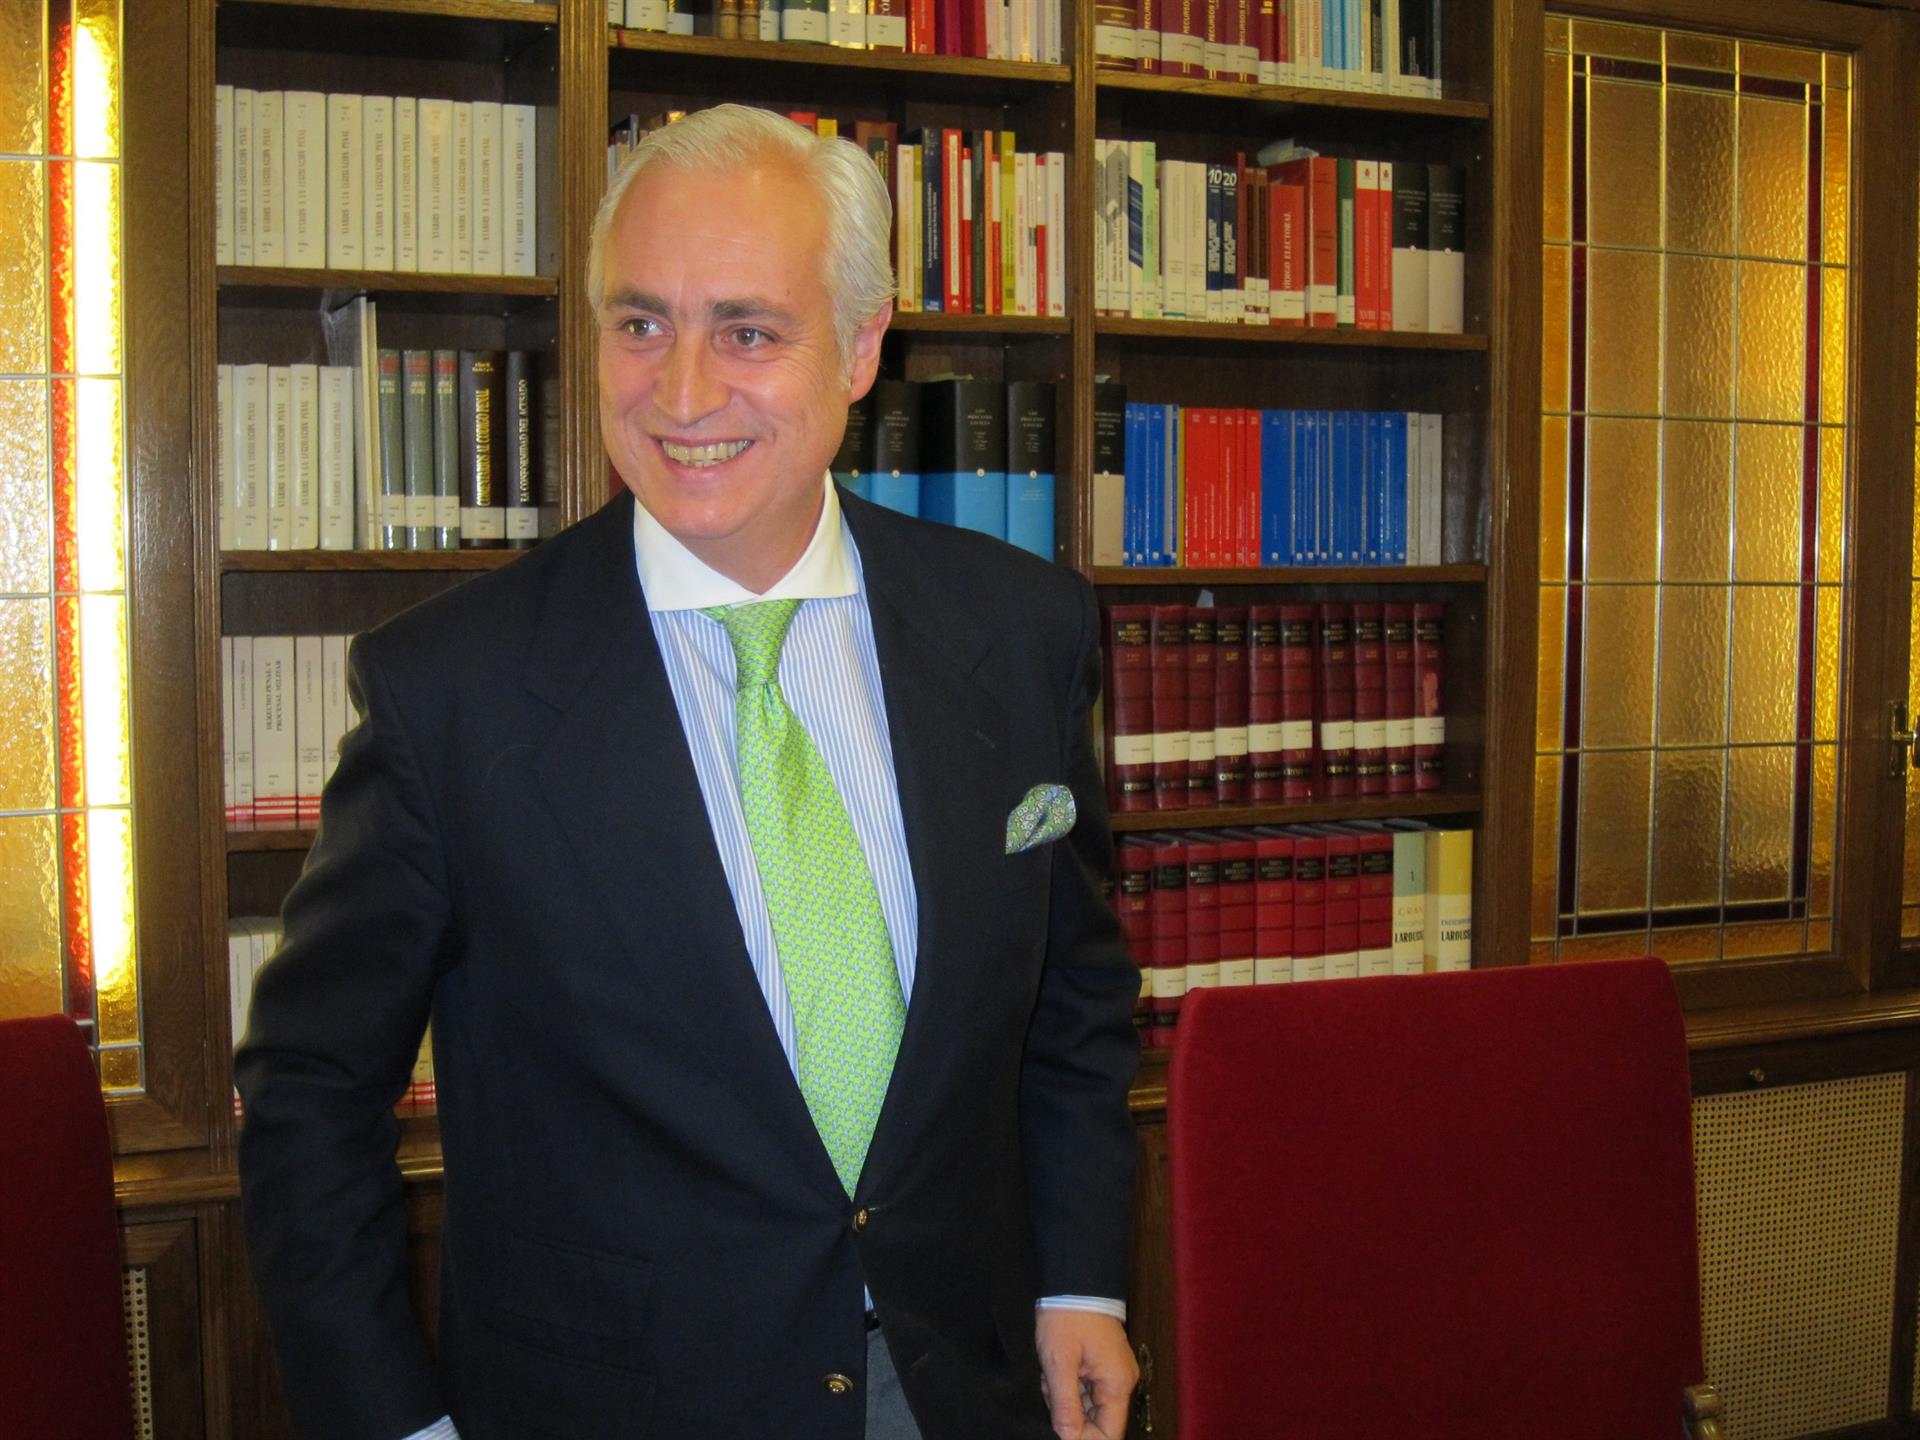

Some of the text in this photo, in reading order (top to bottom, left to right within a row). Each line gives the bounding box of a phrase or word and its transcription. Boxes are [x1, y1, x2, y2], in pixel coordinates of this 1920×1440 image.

[1209, 168, 1222, 184] 10
[1223, 172, 1237, 187] 20
[1283, 213, 1292, 260] ELECTORAL
[475, 388, 489, 412] PENAL
[518, 379, 528, 415] ACUSADO
[519, 417, 528, 433] DEL
[519, 434, 528, 491] CONFORMIDAD
